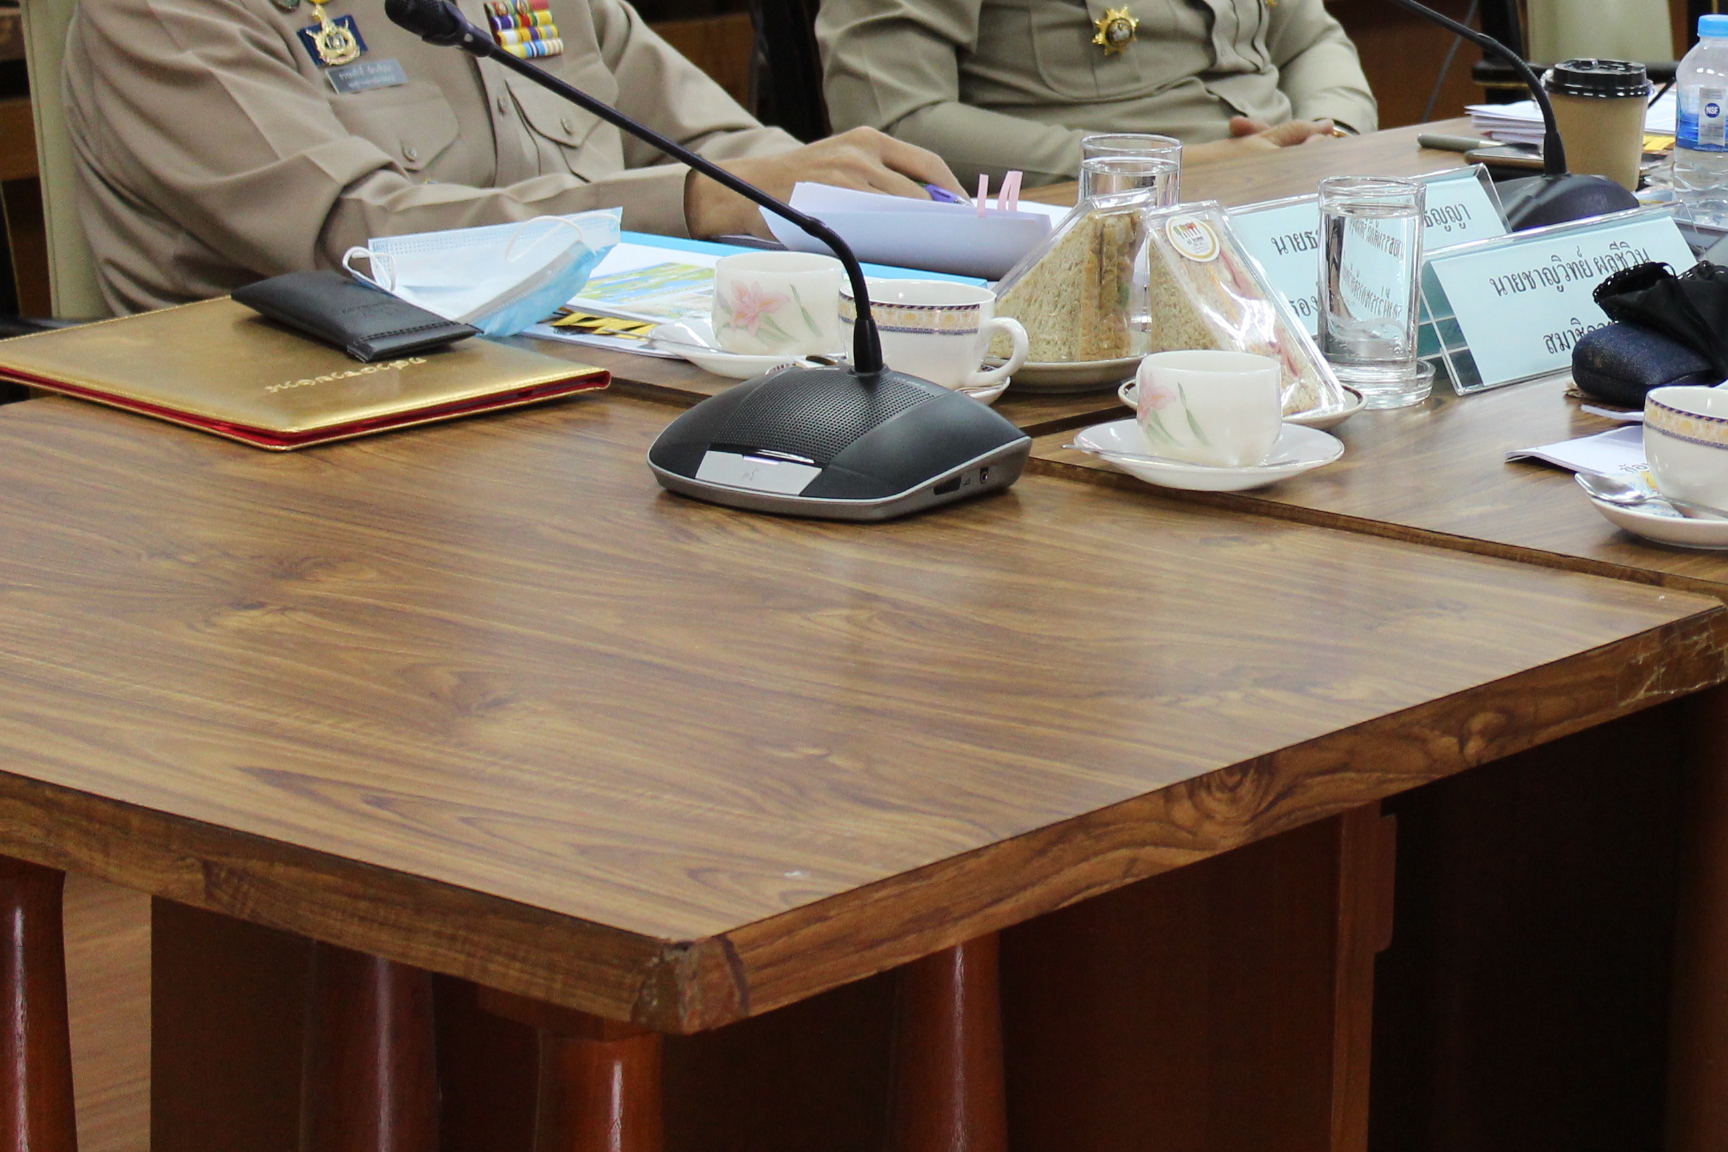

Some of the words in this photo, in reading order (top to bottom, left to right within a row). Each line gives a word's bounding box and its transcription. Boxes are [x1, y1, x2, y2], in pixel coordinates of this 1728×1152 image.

[1705, 105, 1719, 115] NSF
[1489, 245, 1594, 297] นายชาญวิทย์
